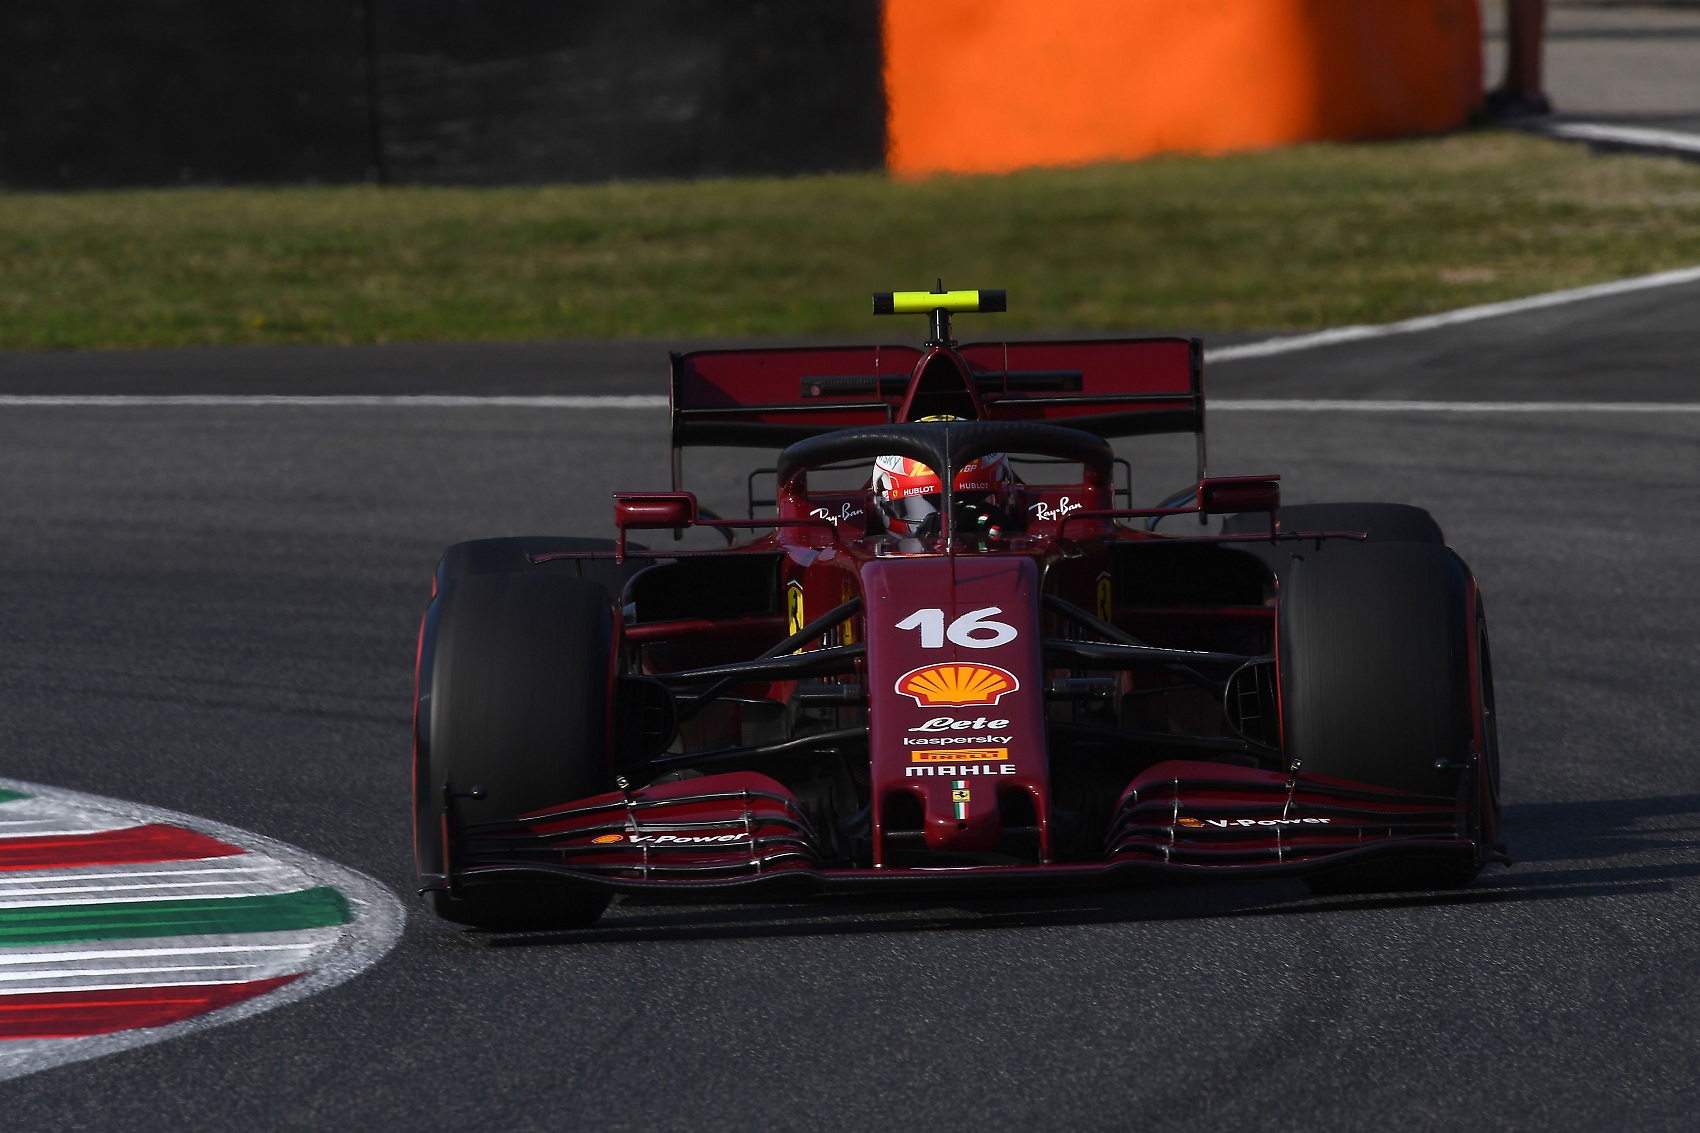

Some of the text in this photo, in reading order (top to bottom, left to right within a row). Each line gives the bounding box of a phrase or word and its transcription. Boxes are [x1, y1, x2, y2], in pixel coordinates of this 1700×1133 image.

[903, 485, 935, 496] HUBLOT
[959, 482, 989, 490] HUBLOT
[1028, 496, 1083, 521] Ray-Ban
[895, 606, 1018, 649] 16
[908, 717, 1010, 732] Lete
[903, 735, 1013, 746] kaspersky
[920, 750, 999, 760] PIRELLI
[905, 764, 1016, 777] MAHLE
[1205, 818, 1331, 828] V-Power
[629, 832, 749, 844] V-Power
